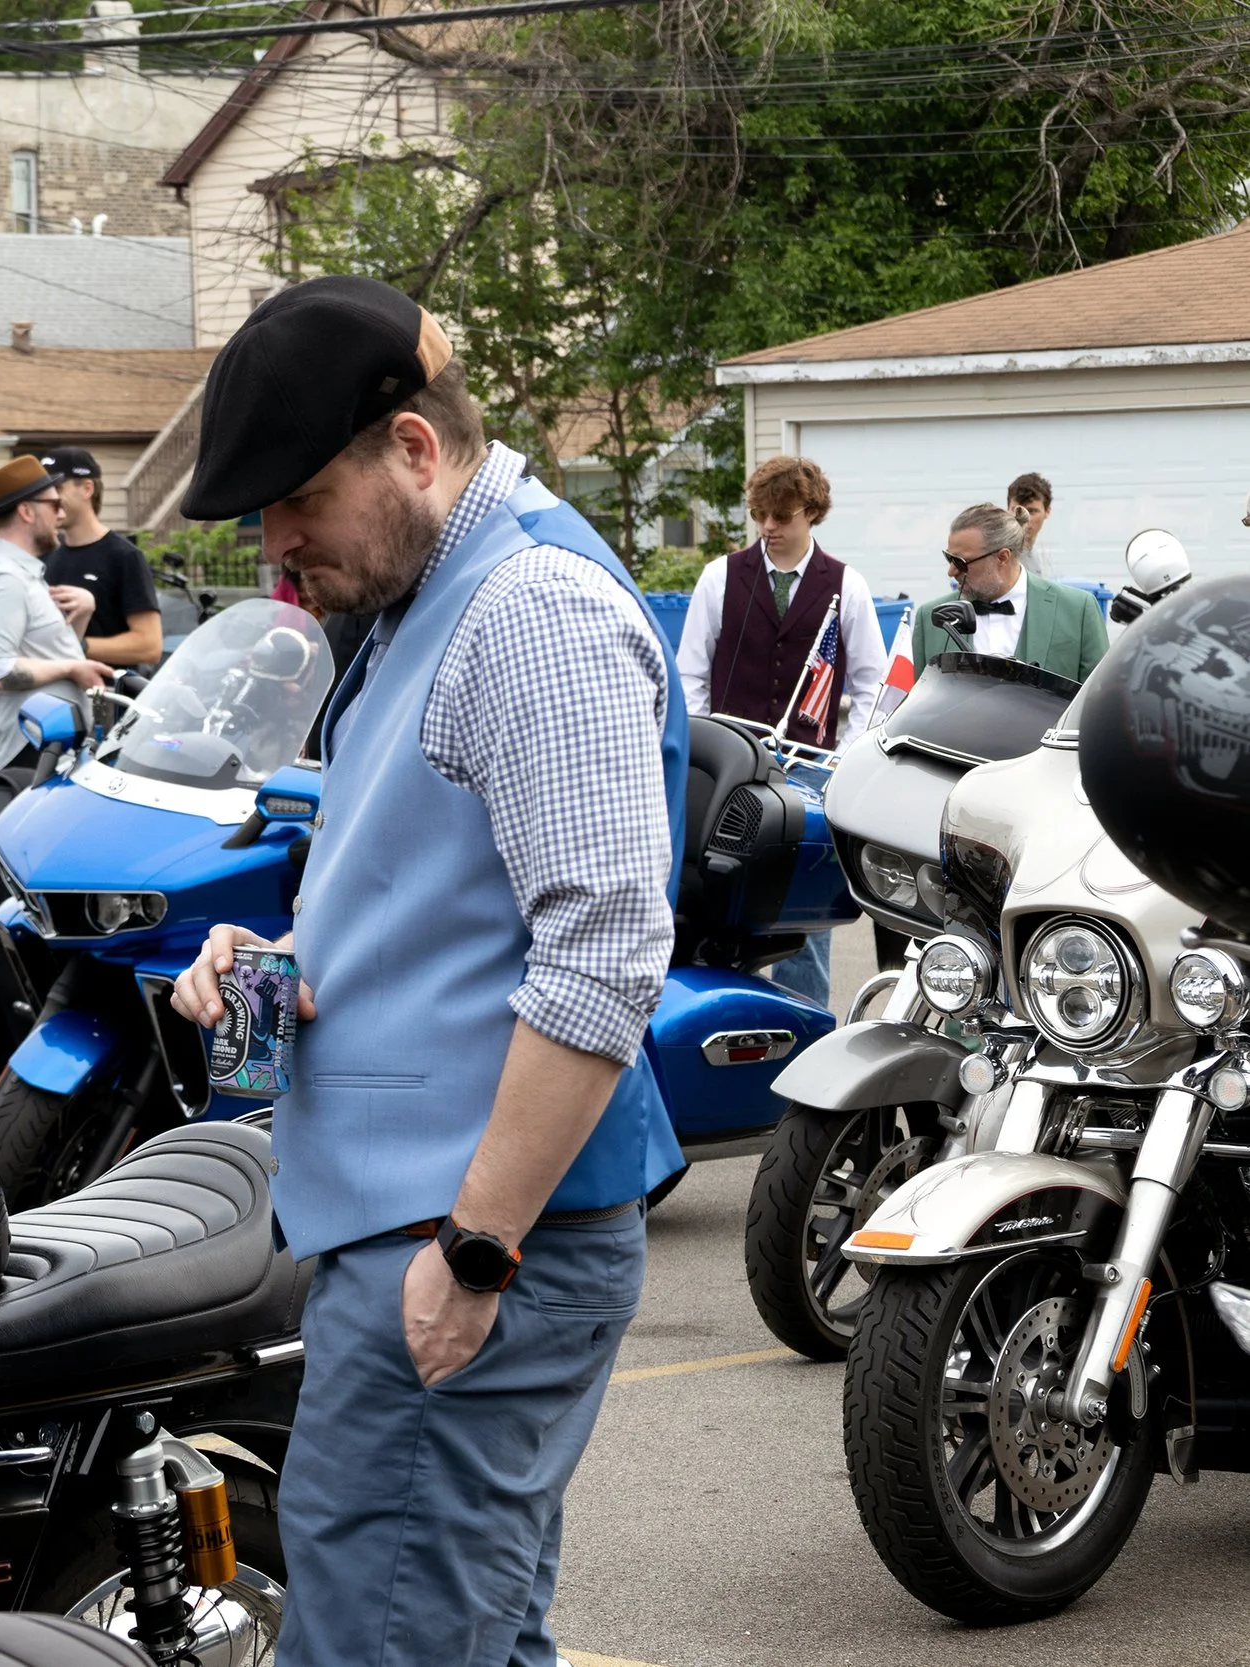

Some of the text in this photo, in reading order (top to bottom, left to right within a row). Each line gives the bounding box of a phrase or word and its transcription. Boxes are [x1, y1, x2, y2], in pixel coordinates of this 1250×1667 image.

[224, 989, 246, 1041] BREWING
[277, 1009, 286, 1036] DAY
[192, 1524, 231, 1550] ÖHLI
